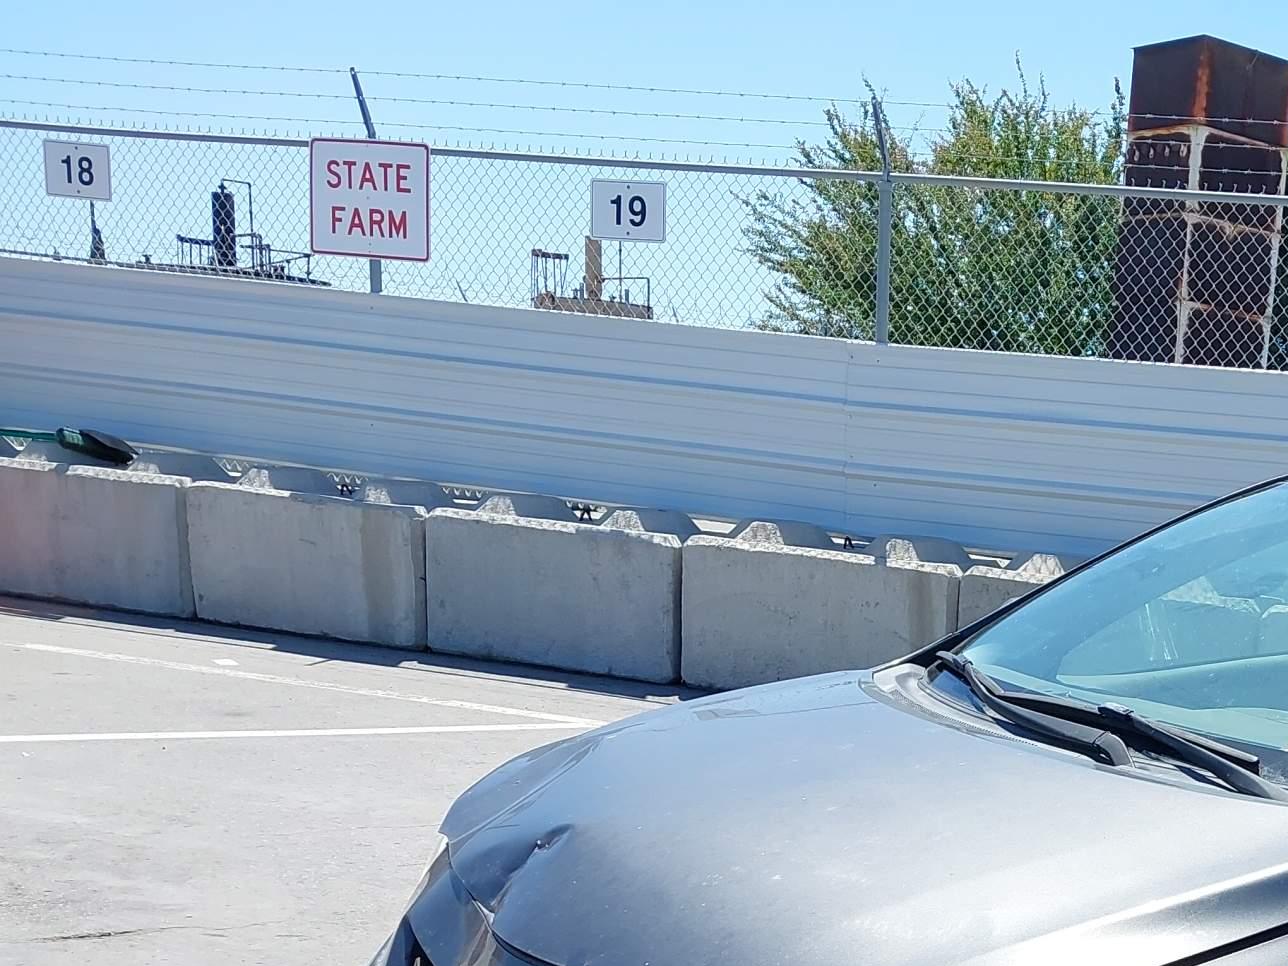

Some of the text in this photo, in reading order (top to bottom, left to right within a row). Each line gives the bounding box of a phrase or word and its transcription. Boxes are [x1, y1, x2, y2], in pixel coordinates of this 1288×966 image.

[61, 155, 94, 186] 18
[326, 160, 412, 193] STATE
[331, 206, 407, 240] FARM
[610, 194, 647, 227] 19
